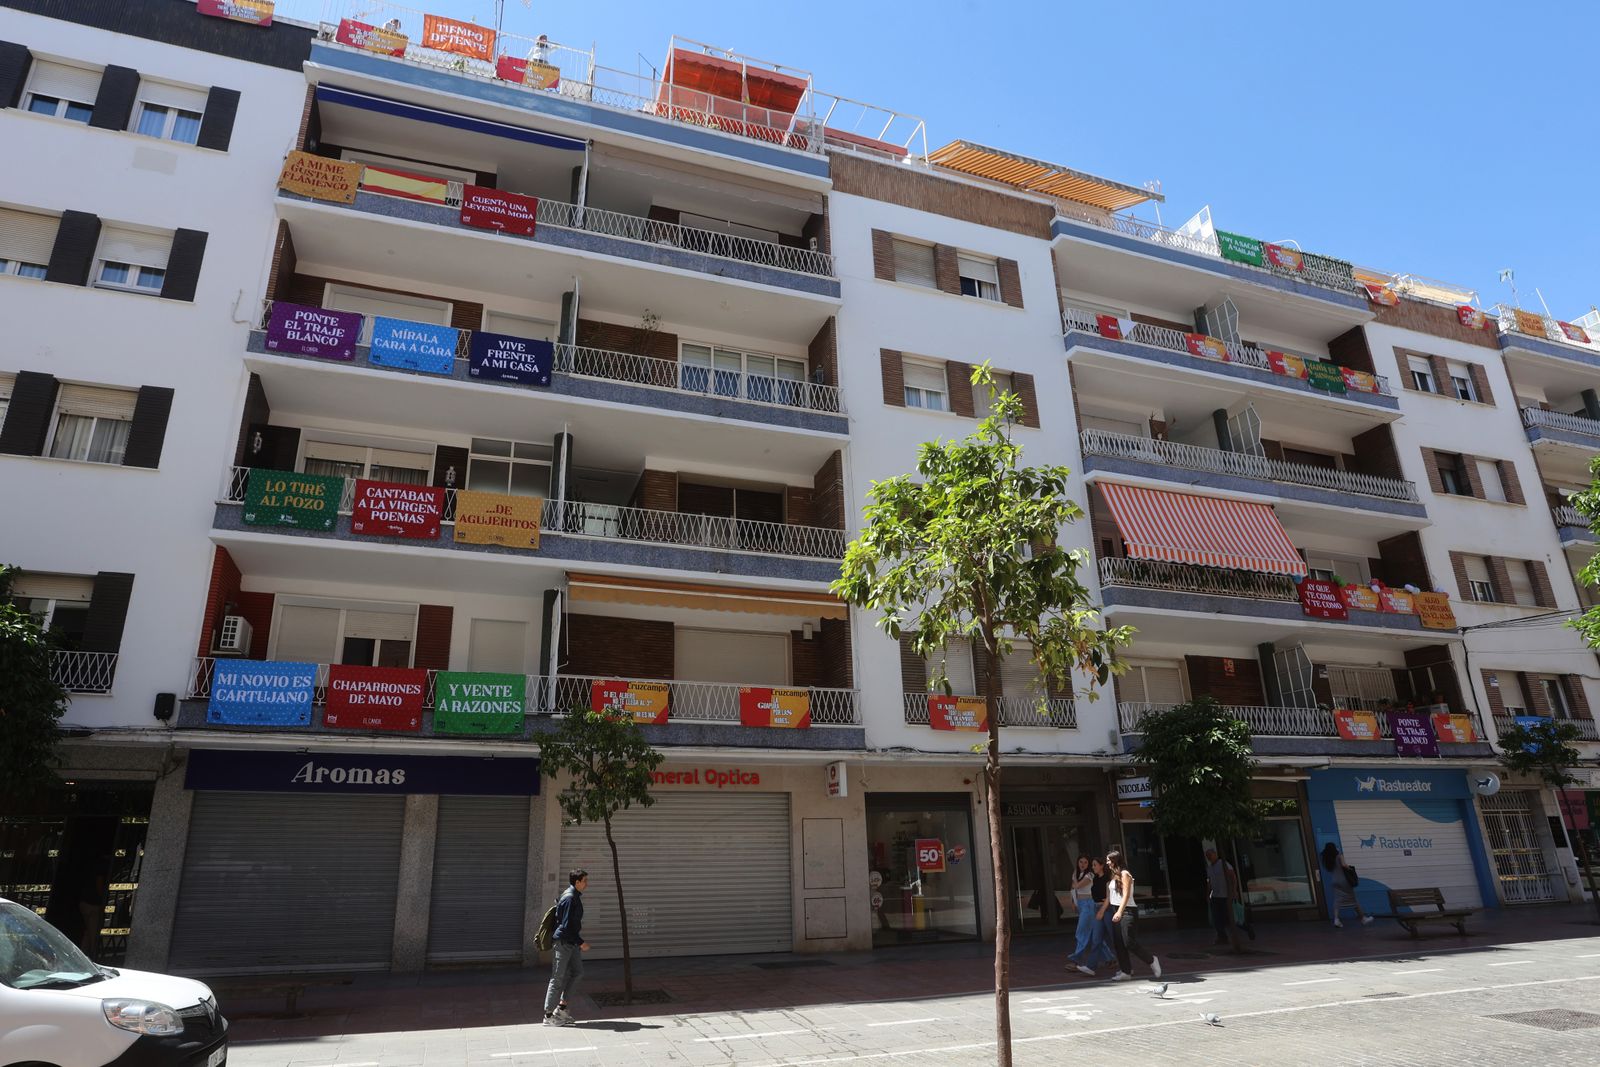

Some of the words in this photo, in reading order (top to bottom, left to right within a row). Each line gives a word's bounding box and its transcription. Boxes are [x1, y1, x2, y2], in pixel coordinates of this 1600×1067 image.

[436, 23, 484, 42] TIEMPO
[430, 32, 488, 53] DETENTE
[290, 164, 328, 181] GUSTA
[331, 174, 347, 183] EL
[297, 157, 305, 167] A
[325, 164, 345, 175] ME
[282, 170, 349, 191] FLAMENCO
[464, 201, 506, 215] LEYENDA
[507, 210, 534, 220] MORA
[472, 195, 508, 208] CUENTA
[509, 202, 528, 213] UNA
[294, 310, 339, 327] PONTE
[284, 320, 301, 330] EL
[303, 322, 345, 338] TRAJE
[391, 328, 438, 344] MÍRALA
[286, 330, 339, 347] BLANCO
[498, 340, 526, 352] VIVE
[374, 337, 406, 351] CARA
[409, 343, 417, 352] A
[420, 345, 452, 357] CARA
[487, 349, 536, 363] FRENTE
[481, 358, 490, 367] A
[492, 359, 507, 369] MI
[509, 361, 540, 373] CASA
[265, 480, 287, 493] LO
[289, 481, 326, 497] TIRÉ
[366, 487, 435, 503] CANTABAN
[259, 495, 280, 507] AL
[283, 495, 325, 511] POZO
[358, 498, 366, 508] A
[370, 499, 386, 510] LA
[370, 510, 425, 524] POEMAS
[459, 513, 538, 530] AGUJERITOS
[1316, 592, 1336, 602] COMO
[1321, 601, 1342, 609] COMO
[217, 672, 237, 686] MI
[240, 673, 289, 688] NOVIO
[292, 675, 312, 688] ES
[332, 679, 421, 695] CHAPARRONES
[627, 682, 668, 693] Cruzcampo
[215, 688, 308, 703] CARTUJANO
[448, 683, 459, 697] Y
[462, 684, 513, 698] VENTE
[771, 689, 808, 698] Cruzcampo
[348, 693, 366, 704] DE
[368, 694, 403, 707] MAYO
[438, 698, 448, 712] A
[451, 700, 521, 714] RAZONES
[1397, 718, 1421, 727] PONTE
[1396, 727, 1406, 736] EL
[1405, 727, 1428, 736] TRAJE
[1402, 736, 1428, 745] BLANCO
[291, 761, 406, 785] Aromas
[648, 768, 699, 785] neral
[704, 768, 760, 788] Optica
[1118, 782, 1151, 794] NICOLAS
[1378, 779, 1432, 792] Rastreator
[1379, 836, 1433, 849] Rastreator
